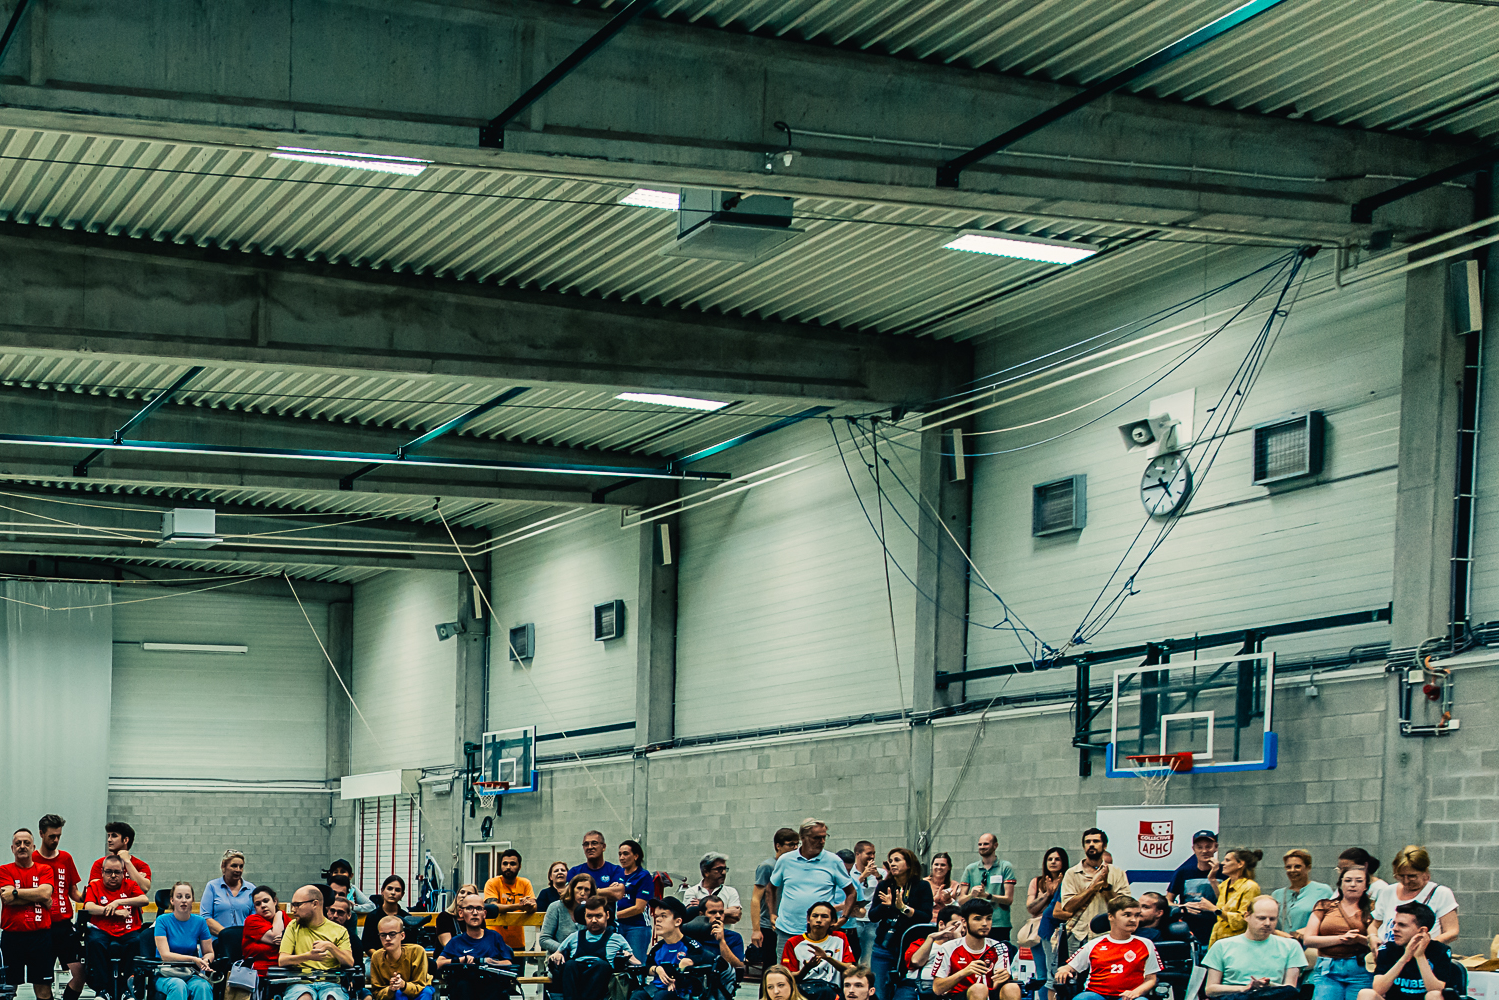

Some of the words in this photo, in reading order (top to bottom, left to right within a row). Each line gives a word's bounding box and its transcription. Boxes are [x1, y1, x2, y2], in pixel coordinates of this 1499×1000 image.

[1142, 842, 1169, 854] APHC
[58, 868, 67, 913] REFEREE
[1110, 964, 1124, 974] 23
